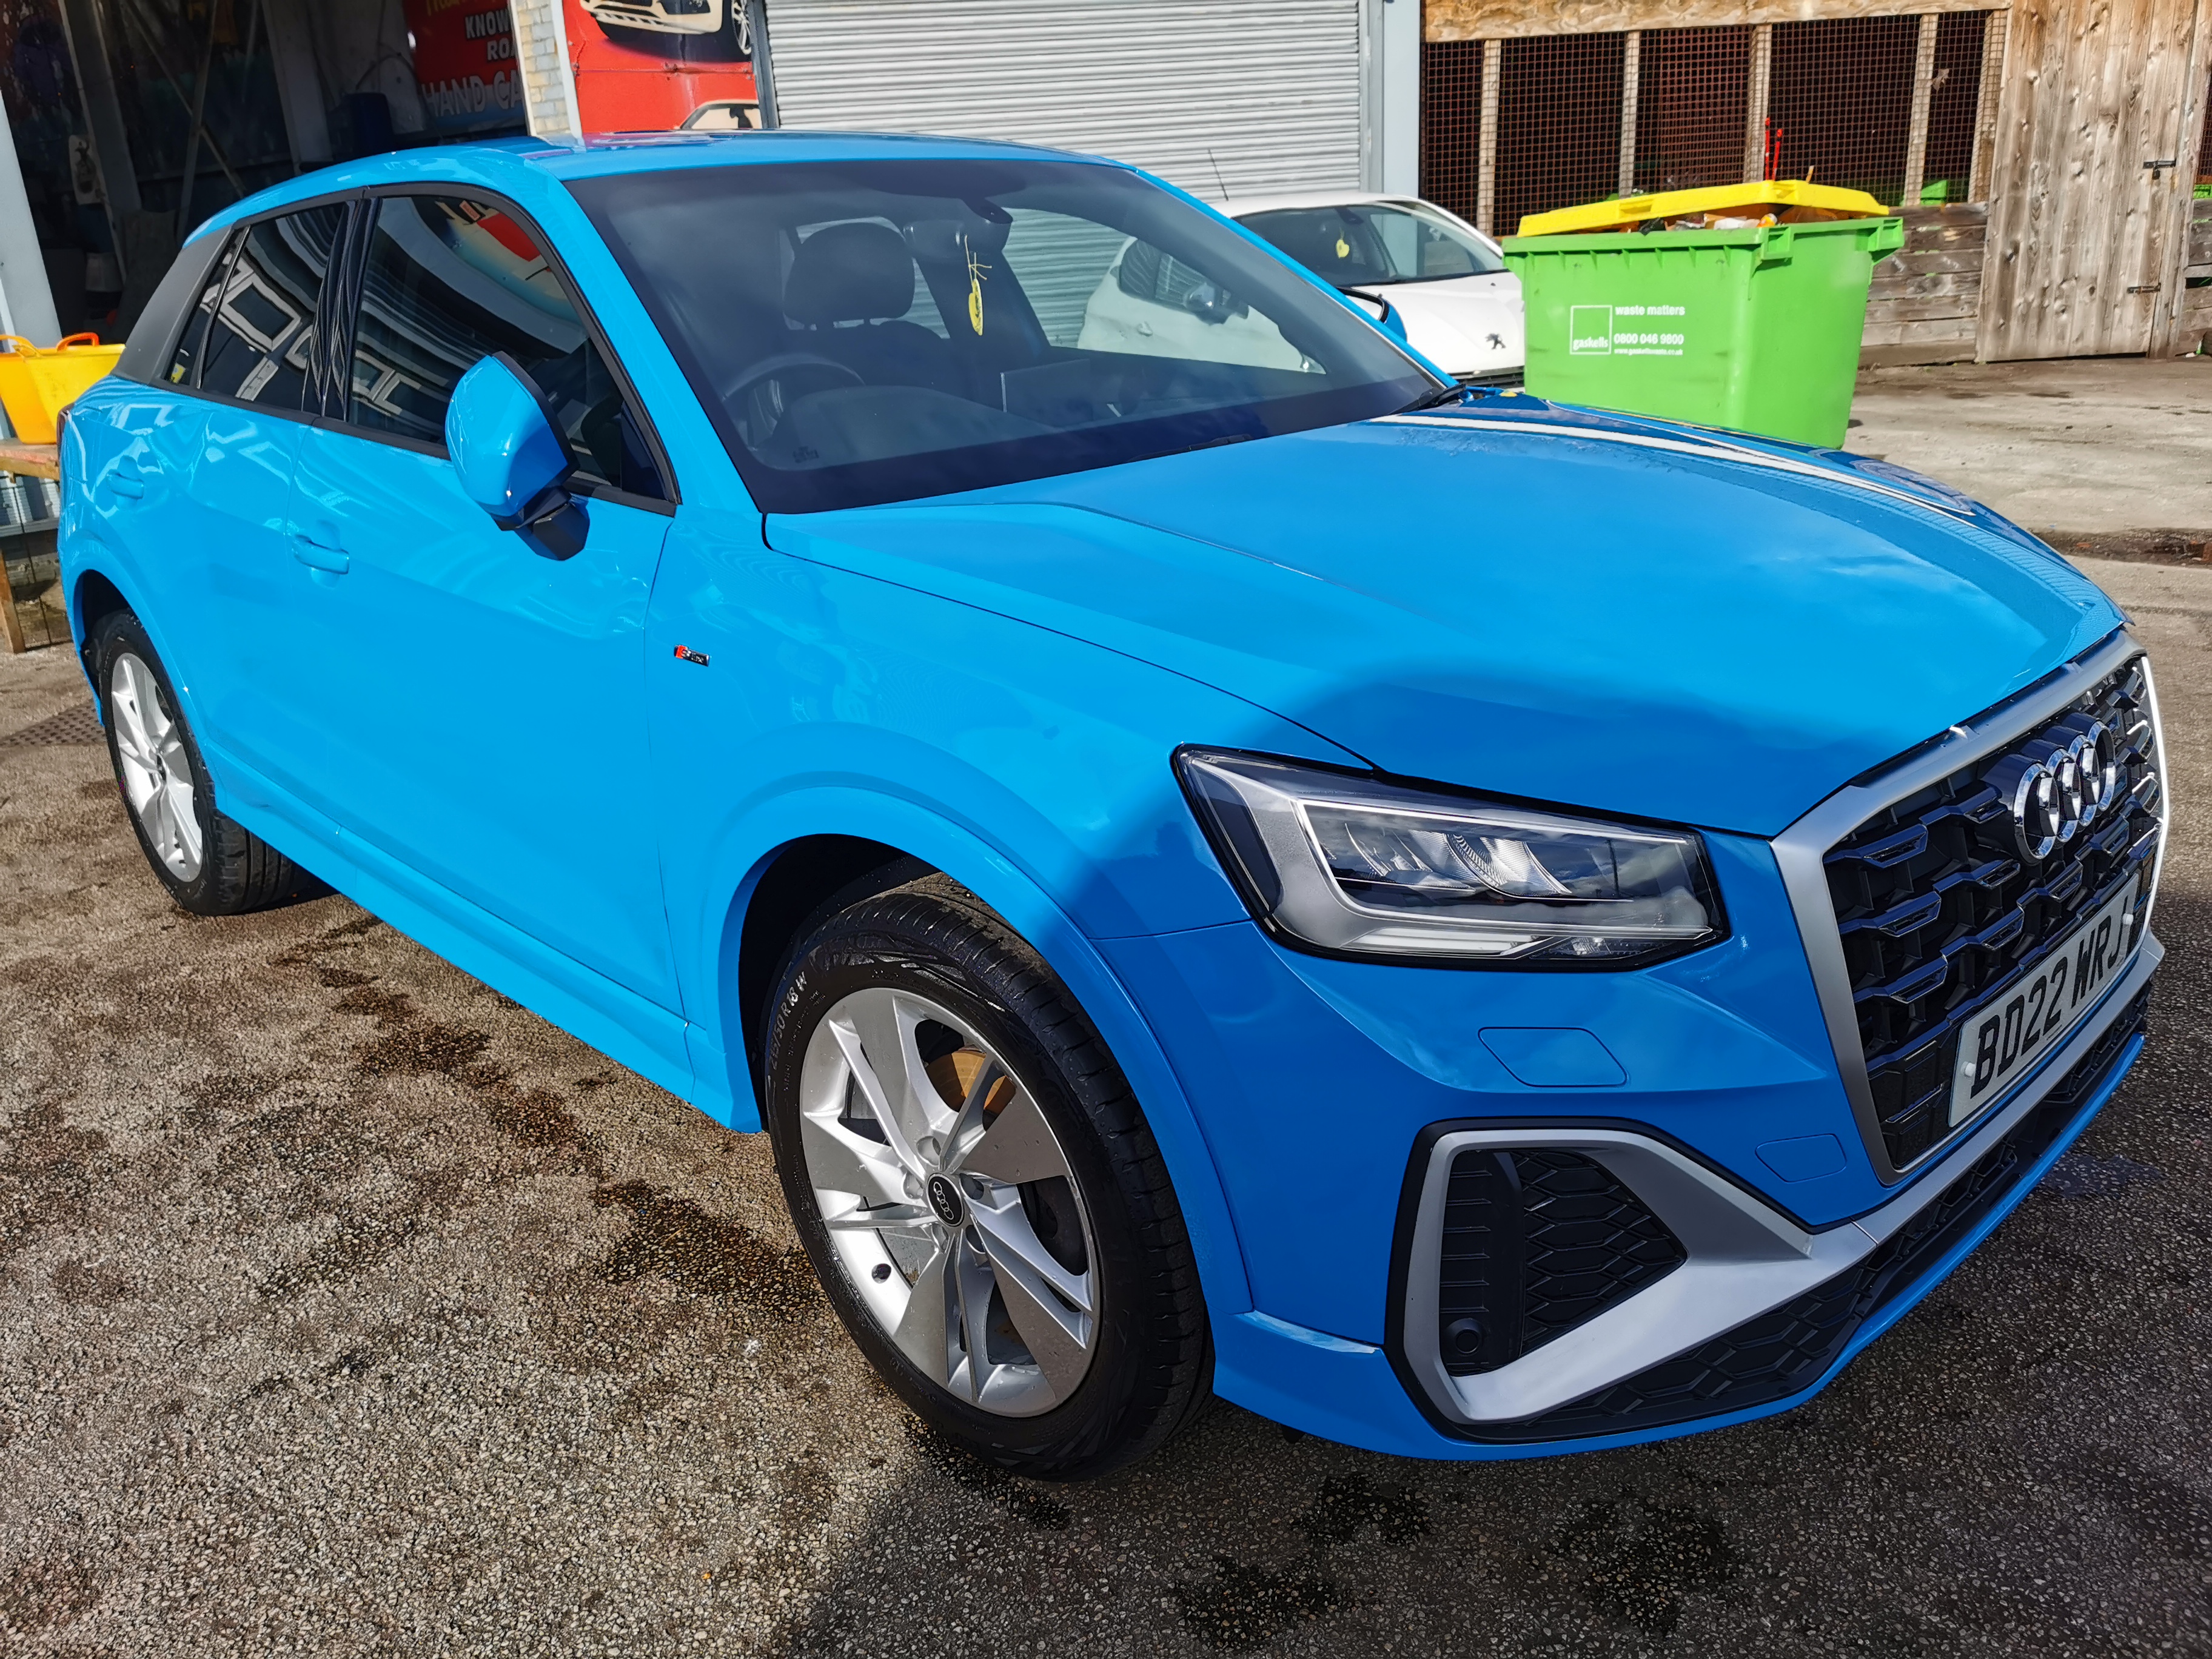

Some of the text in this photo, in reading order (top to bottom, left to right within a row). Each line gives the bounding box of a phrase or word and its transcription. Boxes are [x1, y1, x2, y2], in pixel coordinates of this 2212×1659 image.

[421, 75, 486, 117] HAND
[1615, 305, 1686, 316] waste matters
[1573, 337, 1609, 350] gaskells
[1614, 333, 1684, 345] 0800 046 9800
[1970, 894, 2128, 1099] BD22 WRJ
